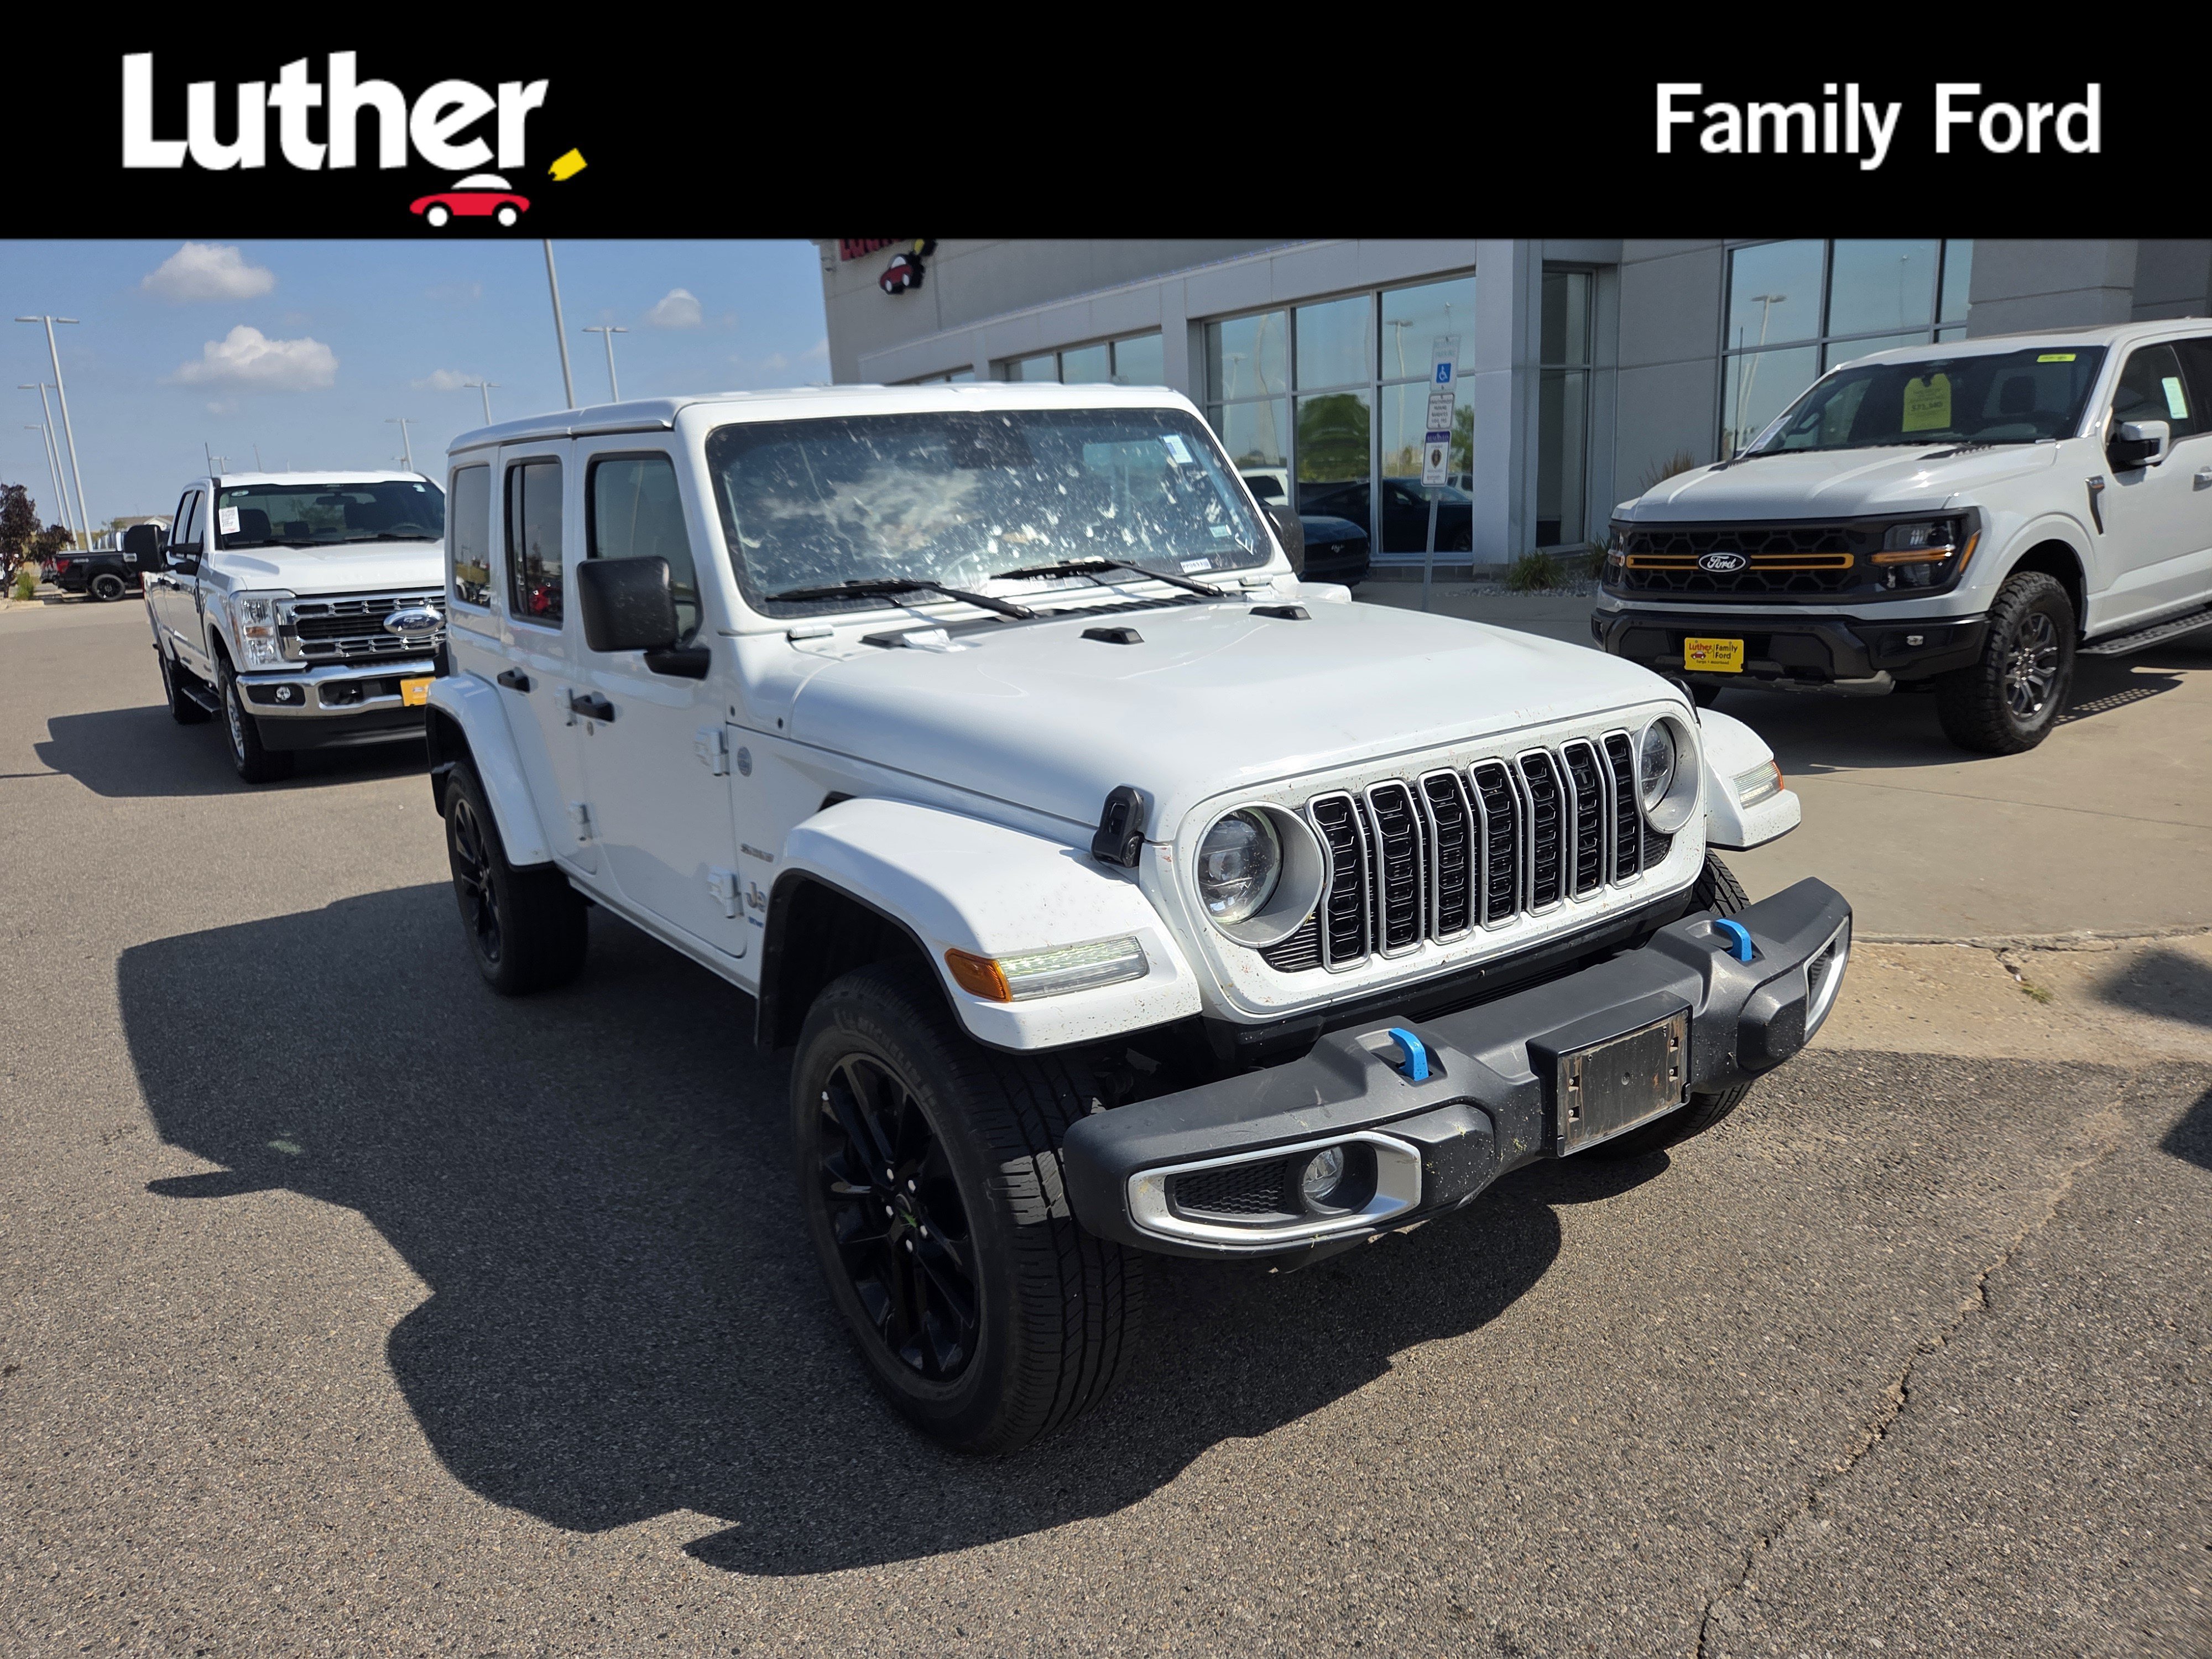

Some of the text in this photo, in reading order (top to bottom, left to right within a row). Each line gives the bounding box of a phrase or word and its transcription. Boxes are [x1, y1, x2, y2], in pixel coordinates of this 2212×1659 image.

[1707, 555, 1736, 569] Ford
[1689, 643, 1712, 651] Luther
[1715, 644, 1738, 653] Family
